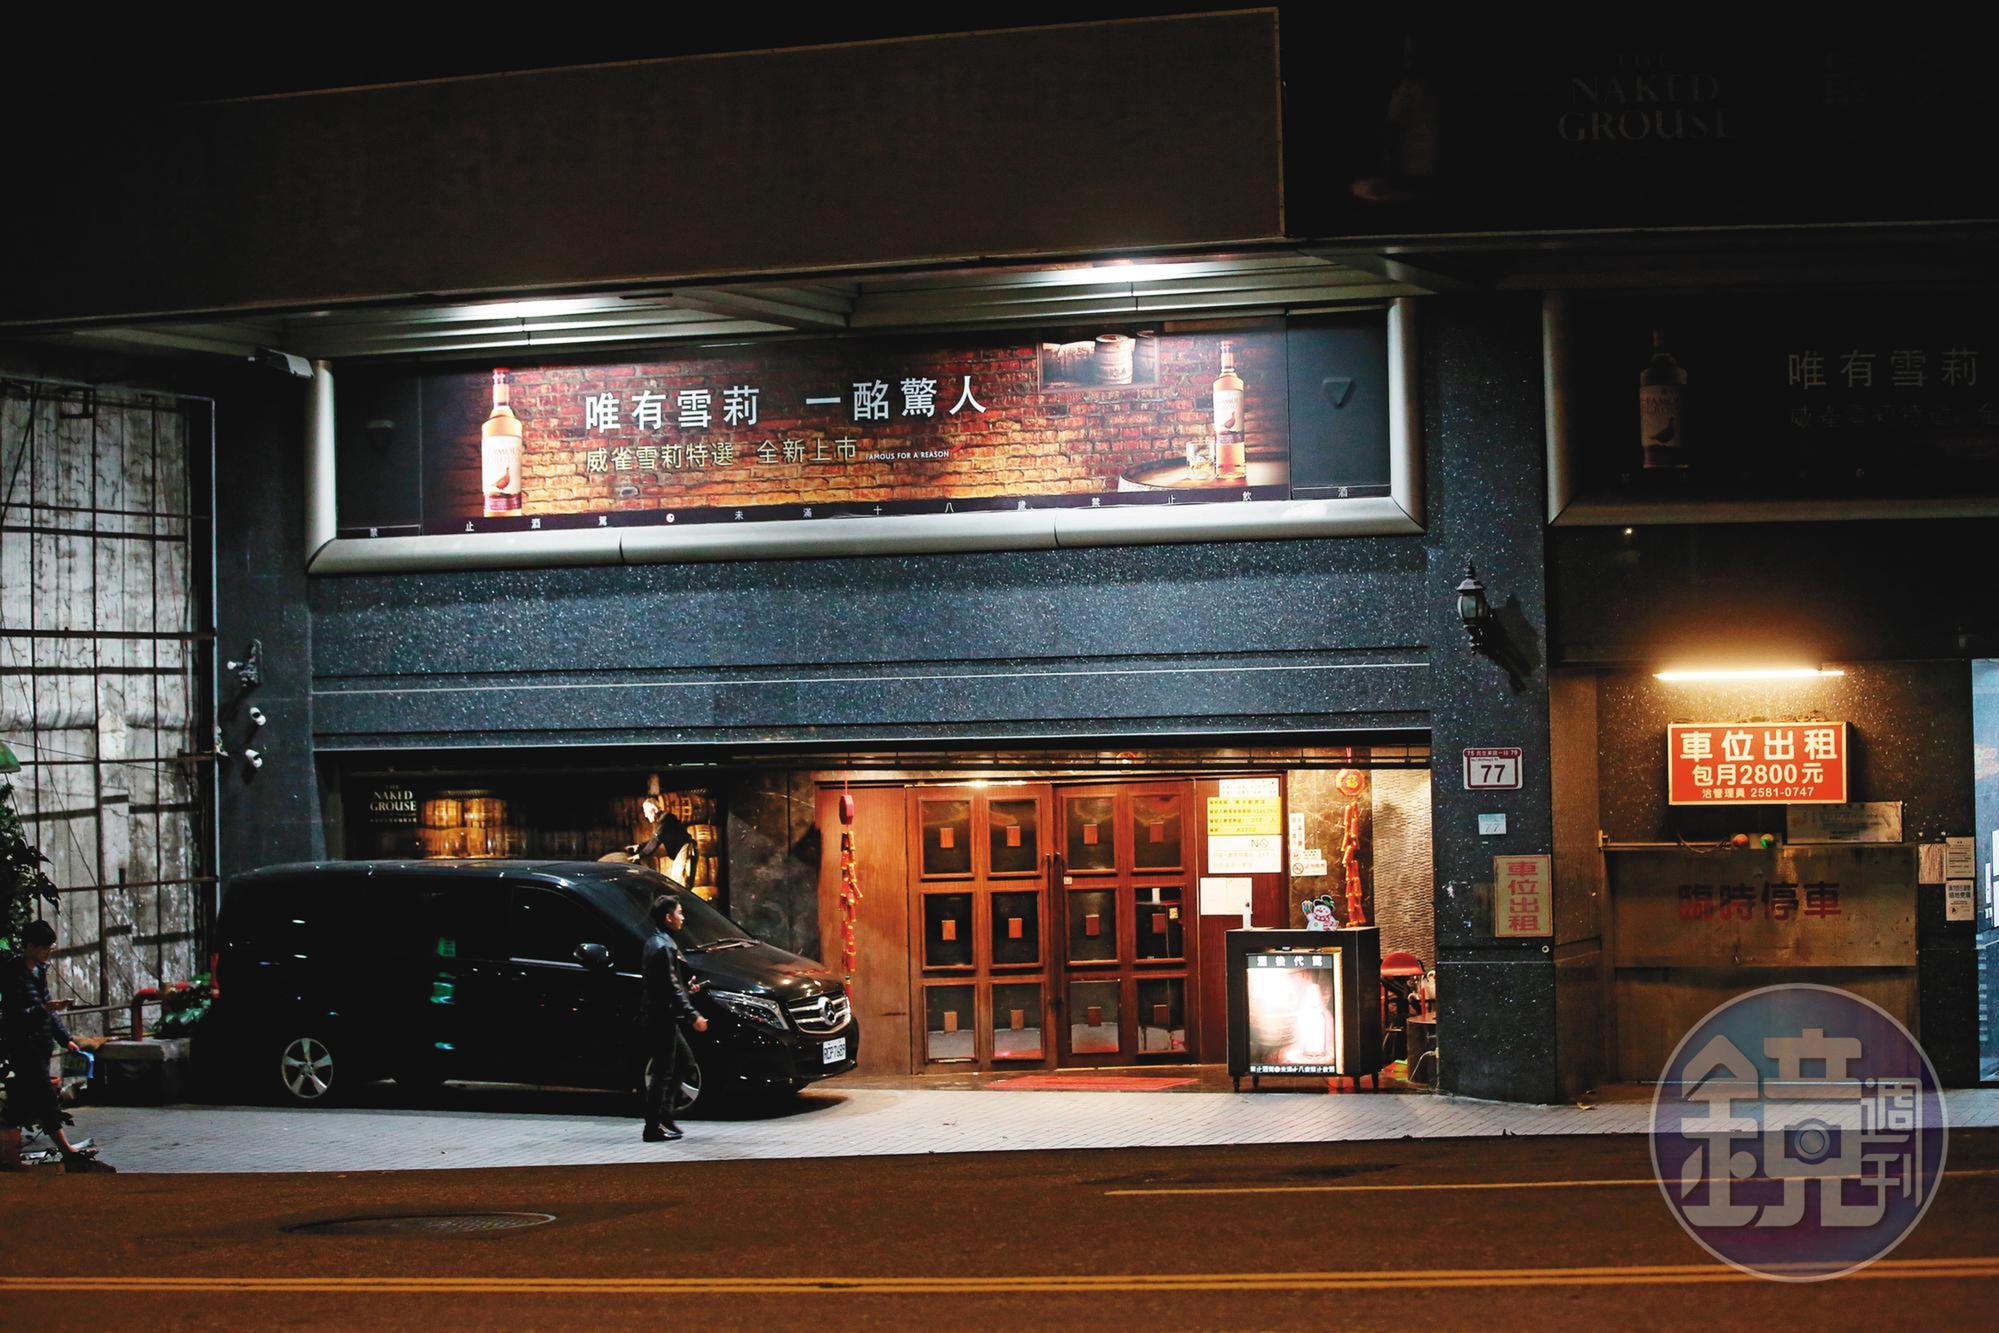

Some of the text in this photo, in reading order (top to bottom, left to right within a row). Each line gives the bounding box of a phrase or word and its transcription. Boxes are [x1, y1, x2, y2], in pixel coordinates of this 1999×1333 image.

[1570, 72, 1720, 106] NAKED
[1787, 345, 1979, 390] 唯有雪莉
[586, 375, 987, 434] 唯有雪莉 一酩驚人
[586, 435, 857, 473] 威雀雪莉特選 全新上市
[865, 450, 950, 461] FAMOUS FOR A REASON
[1680, 729, 1838, 762] 車位出租
[1481, 764, 1506, 783] 77
[1692, 762, 1824, 786] 包月2800元
[369, 800, 417, 812] GROUSE
[373, 790, 414, 801] NAKED
[1750, 786, 1815, 798] 2581-0747
[1505, 861, 1540, 931] 車位出租
